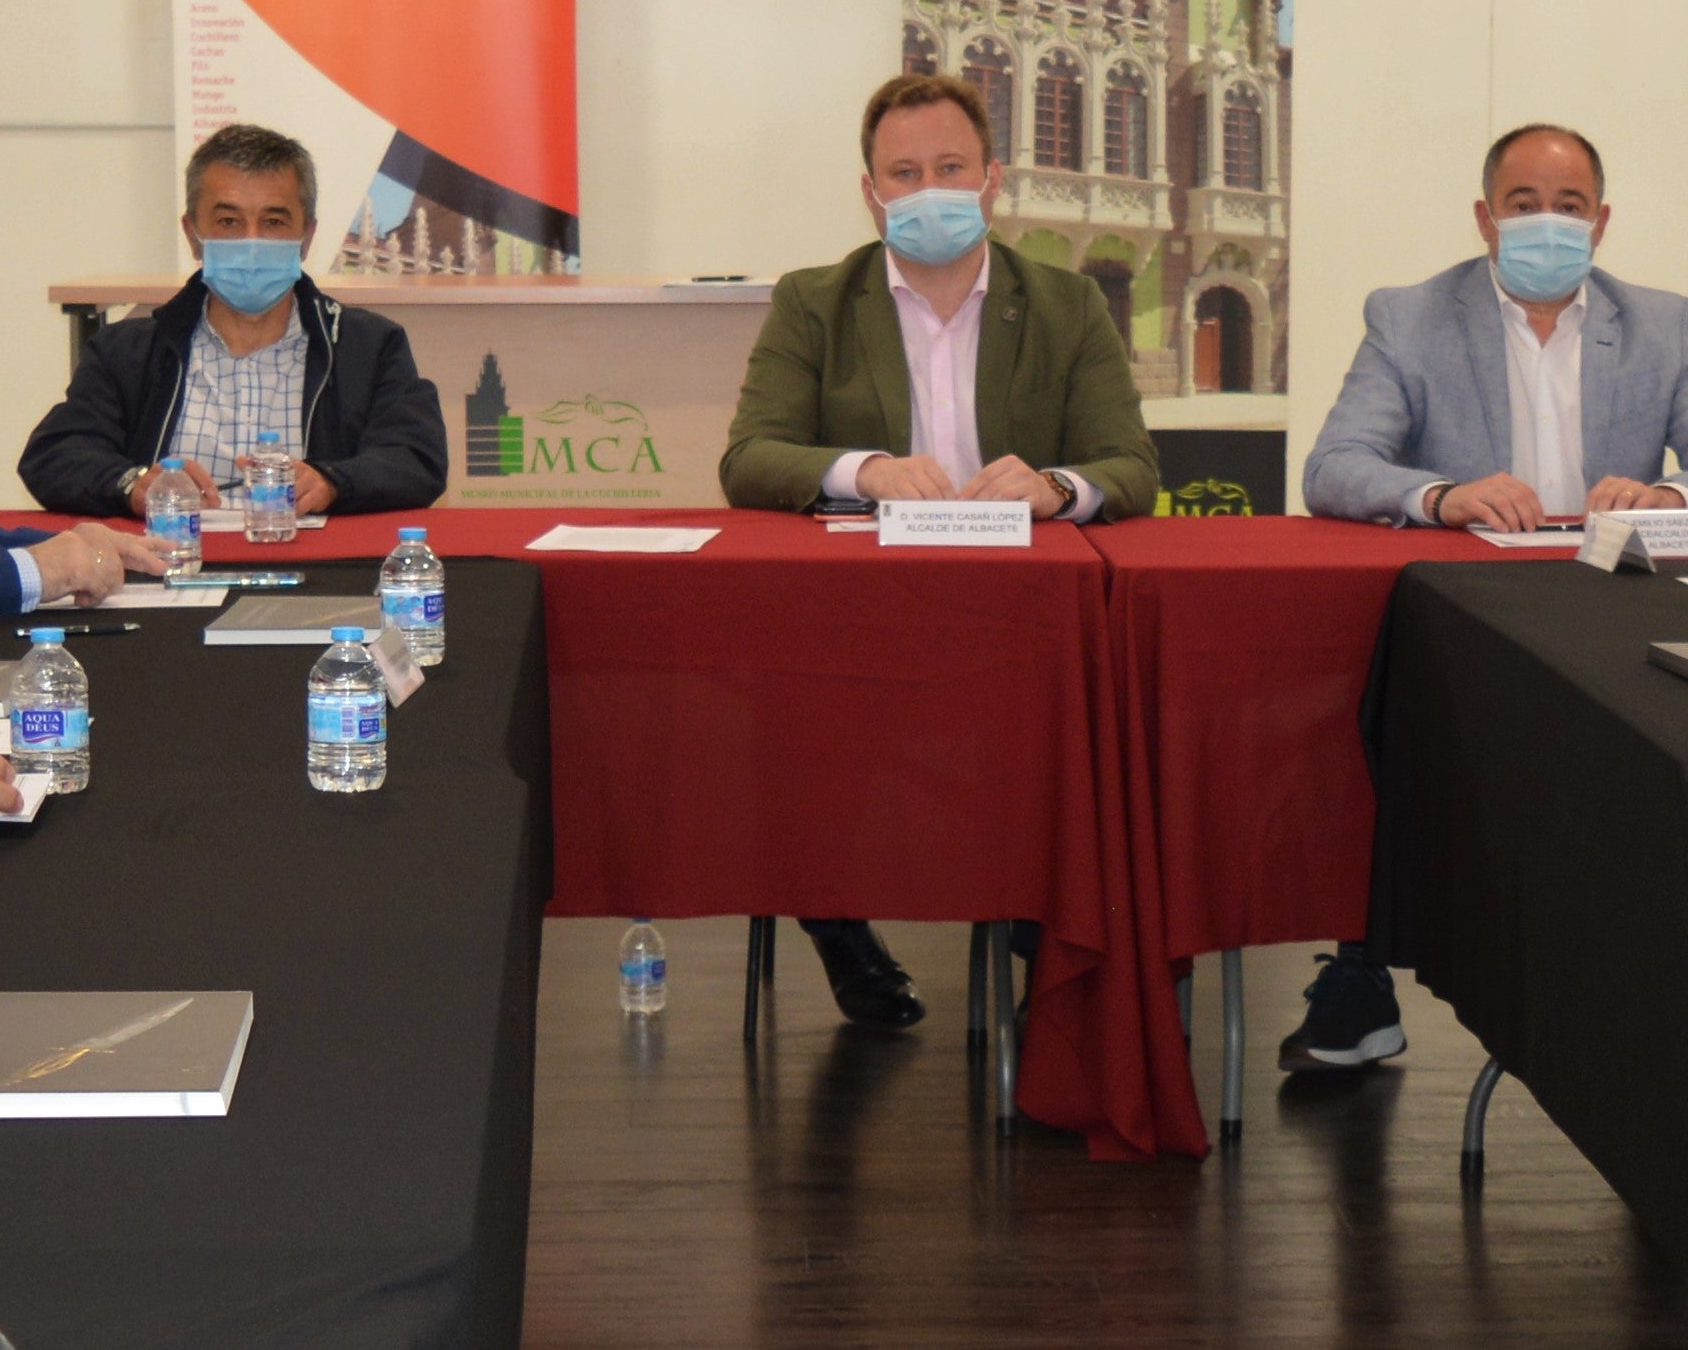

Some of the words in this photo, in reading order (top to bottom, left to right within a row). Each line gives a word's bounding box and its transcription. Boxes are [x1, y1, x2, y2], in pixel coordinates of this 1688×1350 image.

[530, 436, 664, 474] MCA
[913, 513, 953, 522] VICENTE
[906, 524, 950, 534] ALCALDE
[953, 524, 965, 533] DE
[969, 524, 1018, 534] ALBACETE
[25, 714, 60, 723] AQUA
[26, 723, 59, 732] DEUS
